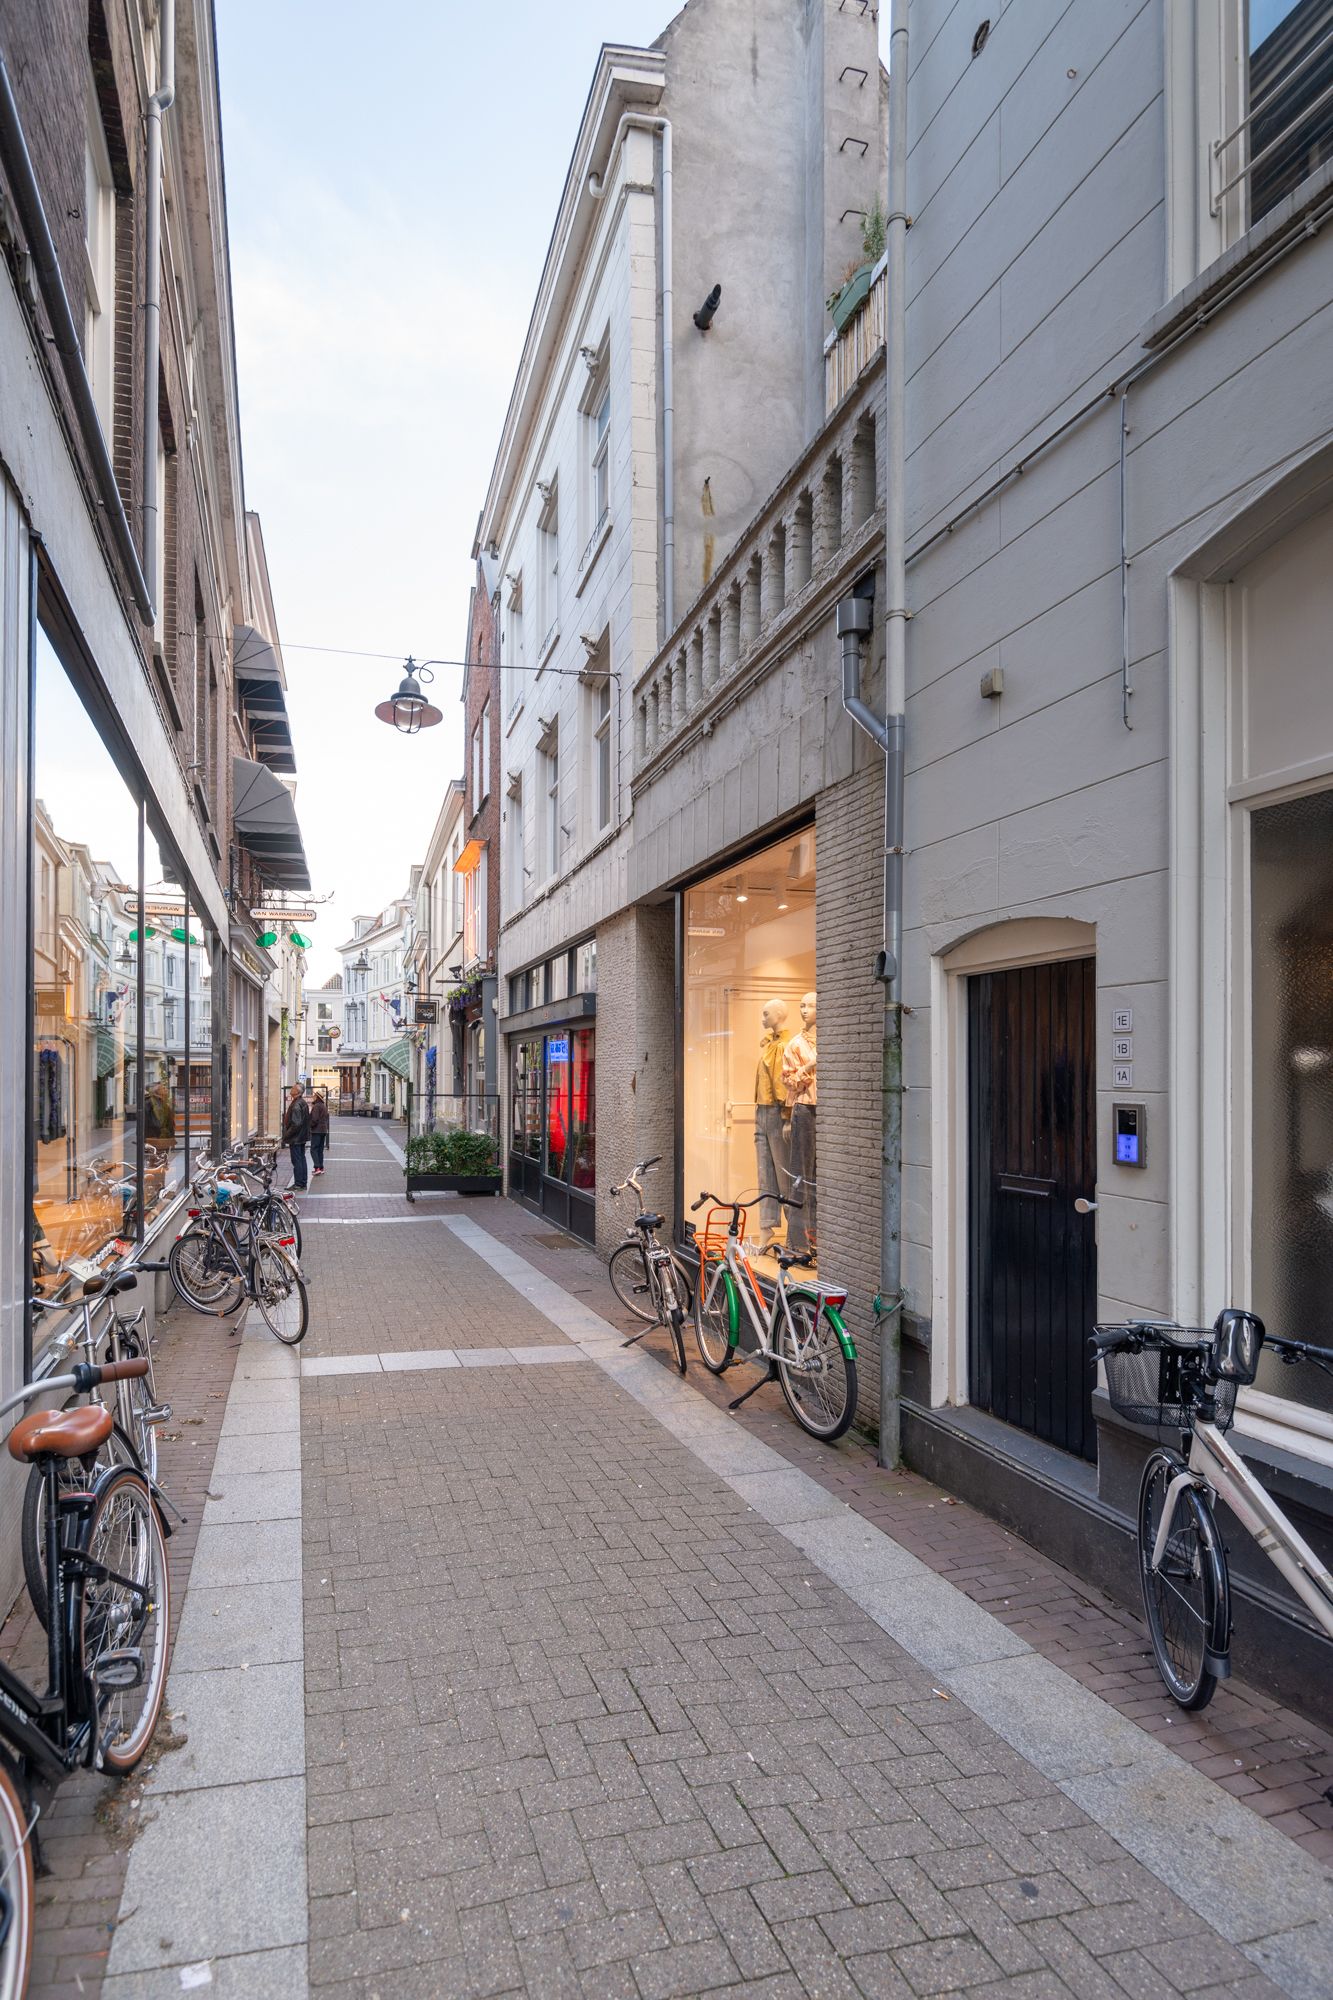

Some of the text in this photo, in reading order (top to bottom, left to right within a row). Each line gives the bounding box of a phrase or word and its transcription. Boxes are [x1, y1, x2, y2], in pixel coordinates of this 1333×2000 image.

[1117, 1015, 1128, 1026] 1E
[1117, 1043, 1128, 1054] 1B
[1117, 1071, 1128, 1081] 1A
